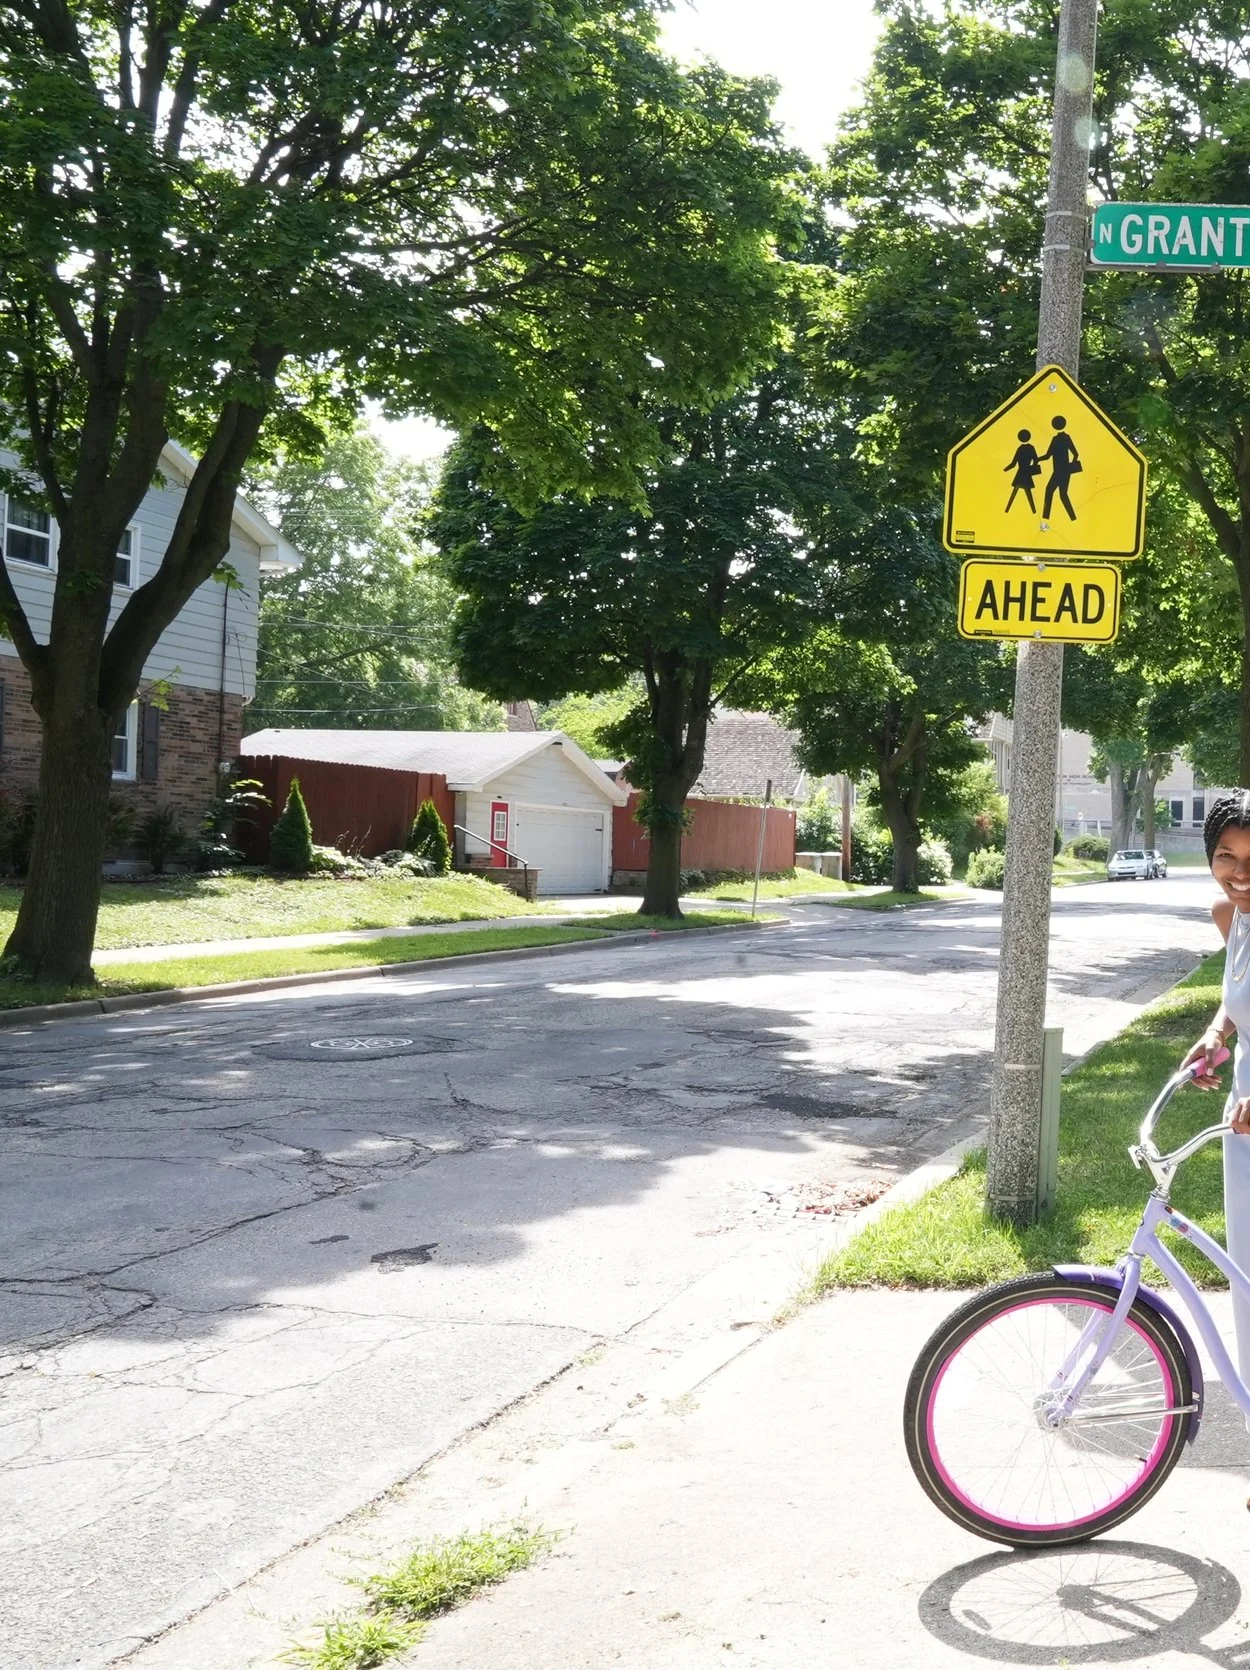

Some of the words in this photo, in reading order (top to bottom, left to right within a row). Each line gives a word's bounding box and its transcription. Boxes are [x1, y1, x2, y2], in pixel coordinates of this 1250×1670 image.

[1100, 223, 1112, 244] N
[1120, 214, 1250, 257] GRANT
[974, 579, 1105, 624] AHEAD
